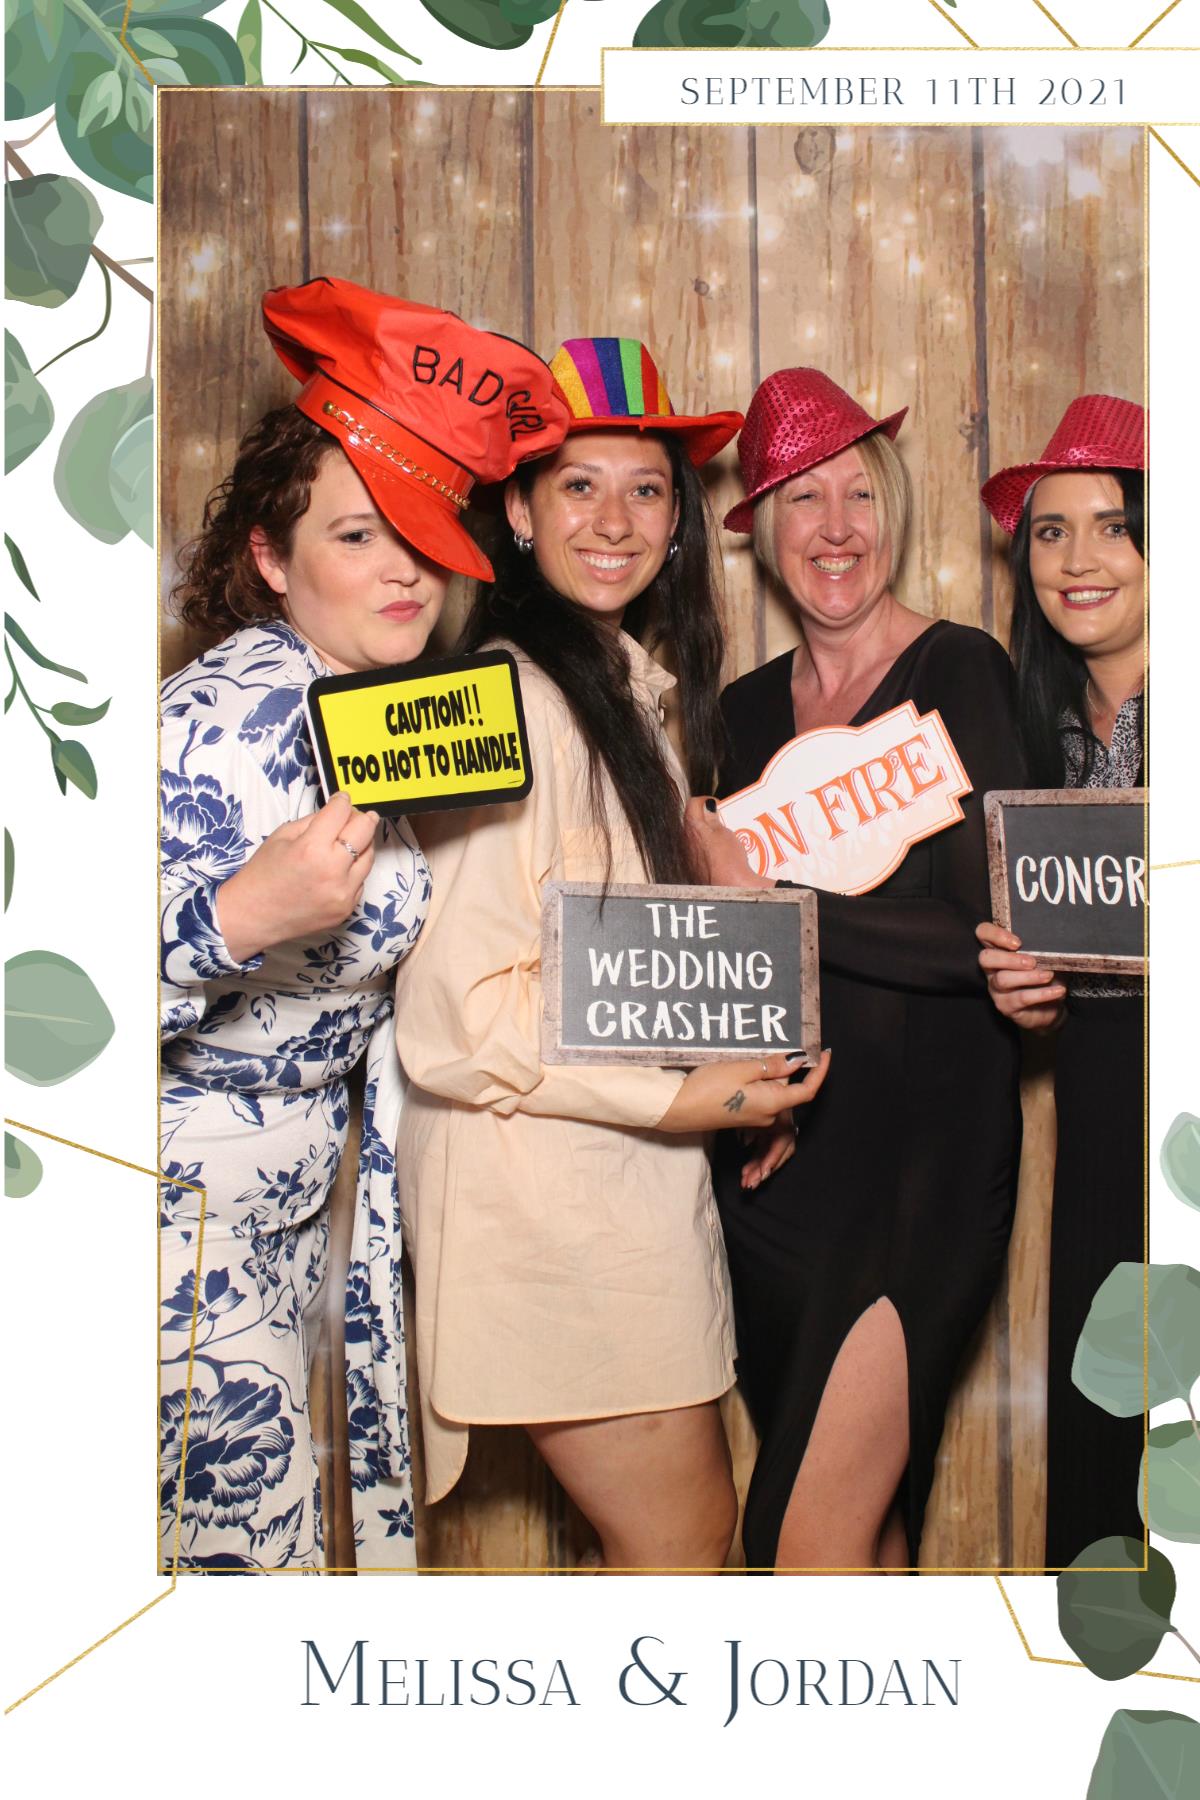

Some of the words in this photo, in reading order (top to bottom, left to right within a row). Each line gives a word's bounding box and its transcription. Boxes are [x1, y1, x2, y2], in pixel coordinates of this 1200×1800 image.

[413, 344, 504, 406] BAD
[506, 390, 548, 442] GIRL
[385, 684, 484, 736] CAUTION!!
[337, 752, 380, 785] TOO
[382, 746, 421, 782] HOT
[423, 744, 450, 777] TO
[451, 732, 521, 776] HANDLE
[805, 733, 947, 840] FIRE
[646, 903, 720, 939] THE
[588, 948, 773, 990] WEDDING
[586, 1001, 790, 1042] CRASHER
